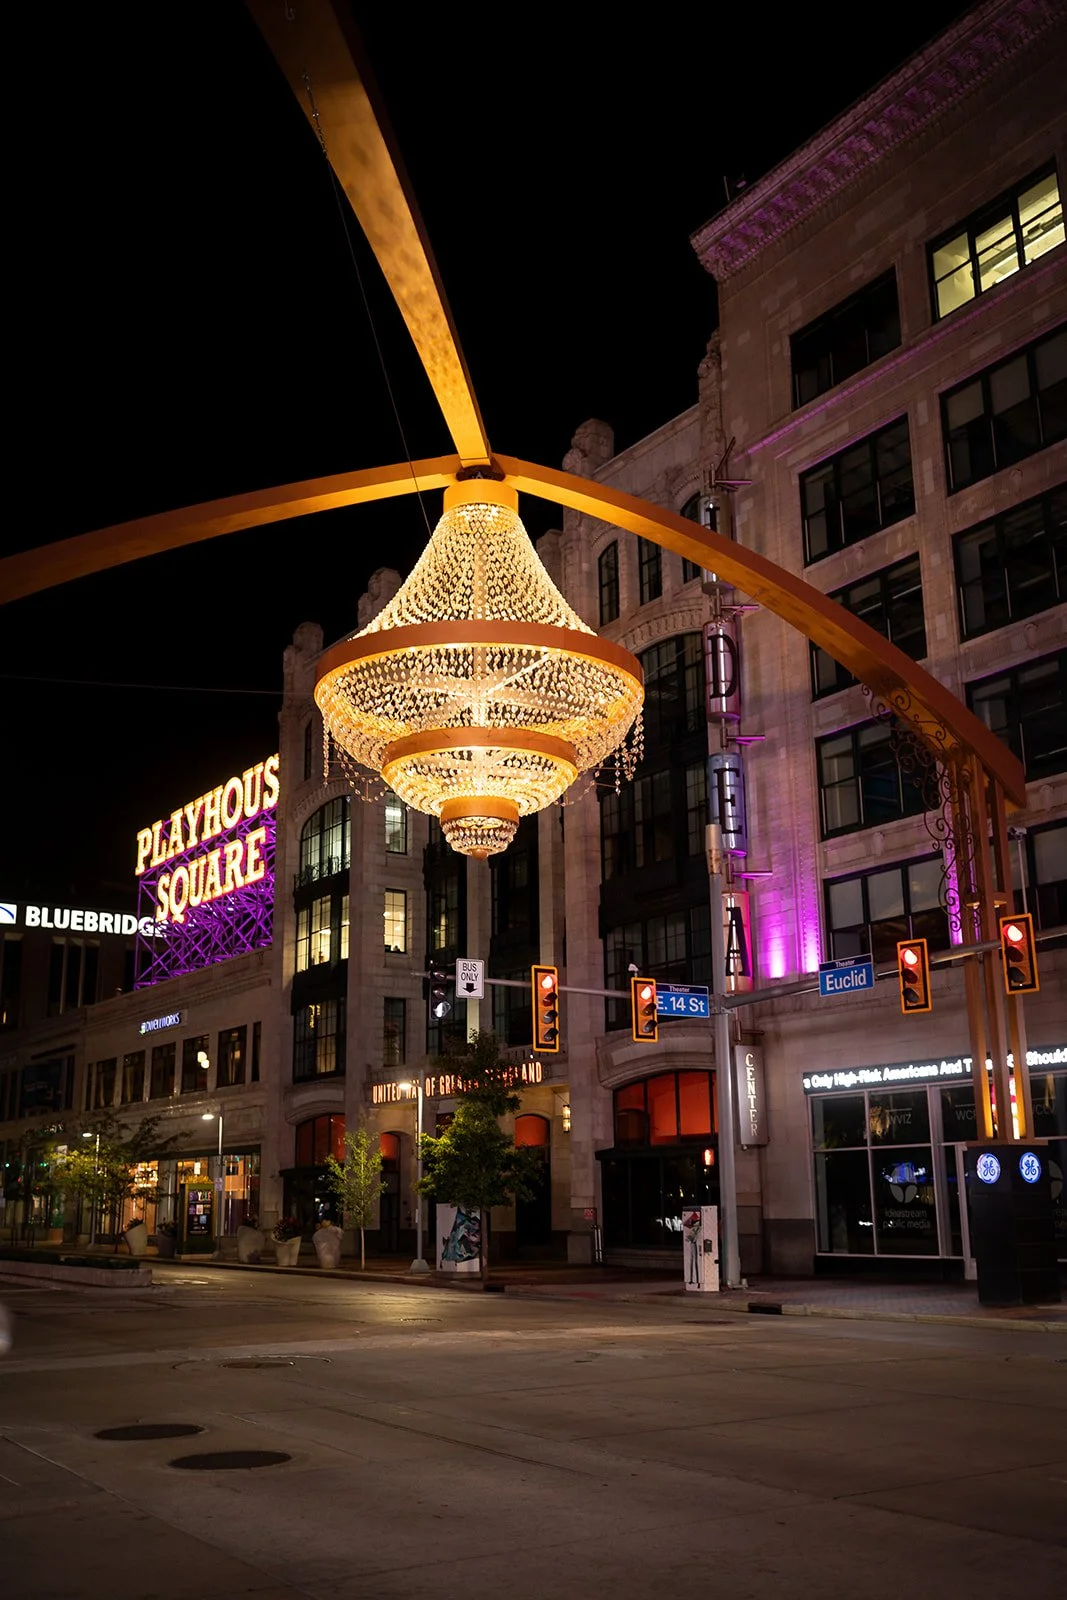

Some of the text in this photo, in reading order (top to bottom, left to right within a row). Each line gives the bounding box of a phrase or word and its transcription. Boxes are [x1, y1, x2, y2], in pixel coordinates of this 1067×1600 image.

[135, 752, 280, 876] PLAYHOUS
[156, 826, 266, 924] SQUARE
[462, 962, 477, 972] BUS
[836, 958, 855, 968] Theater
[460, 971, 479, 982] ONLY
[825, 968, 867, 991] Euclid
[669, 985, 690, 994] Theater
[672, 996, 686, 1012] 14
[689, 997, 705, 1013] St
[883, 1064, 938, 1081] Americans
[940, 1059, 962, 1075] And
[425, 1077, 436, 1097] OF
[745, 1053, 758, 1137] CENTER
